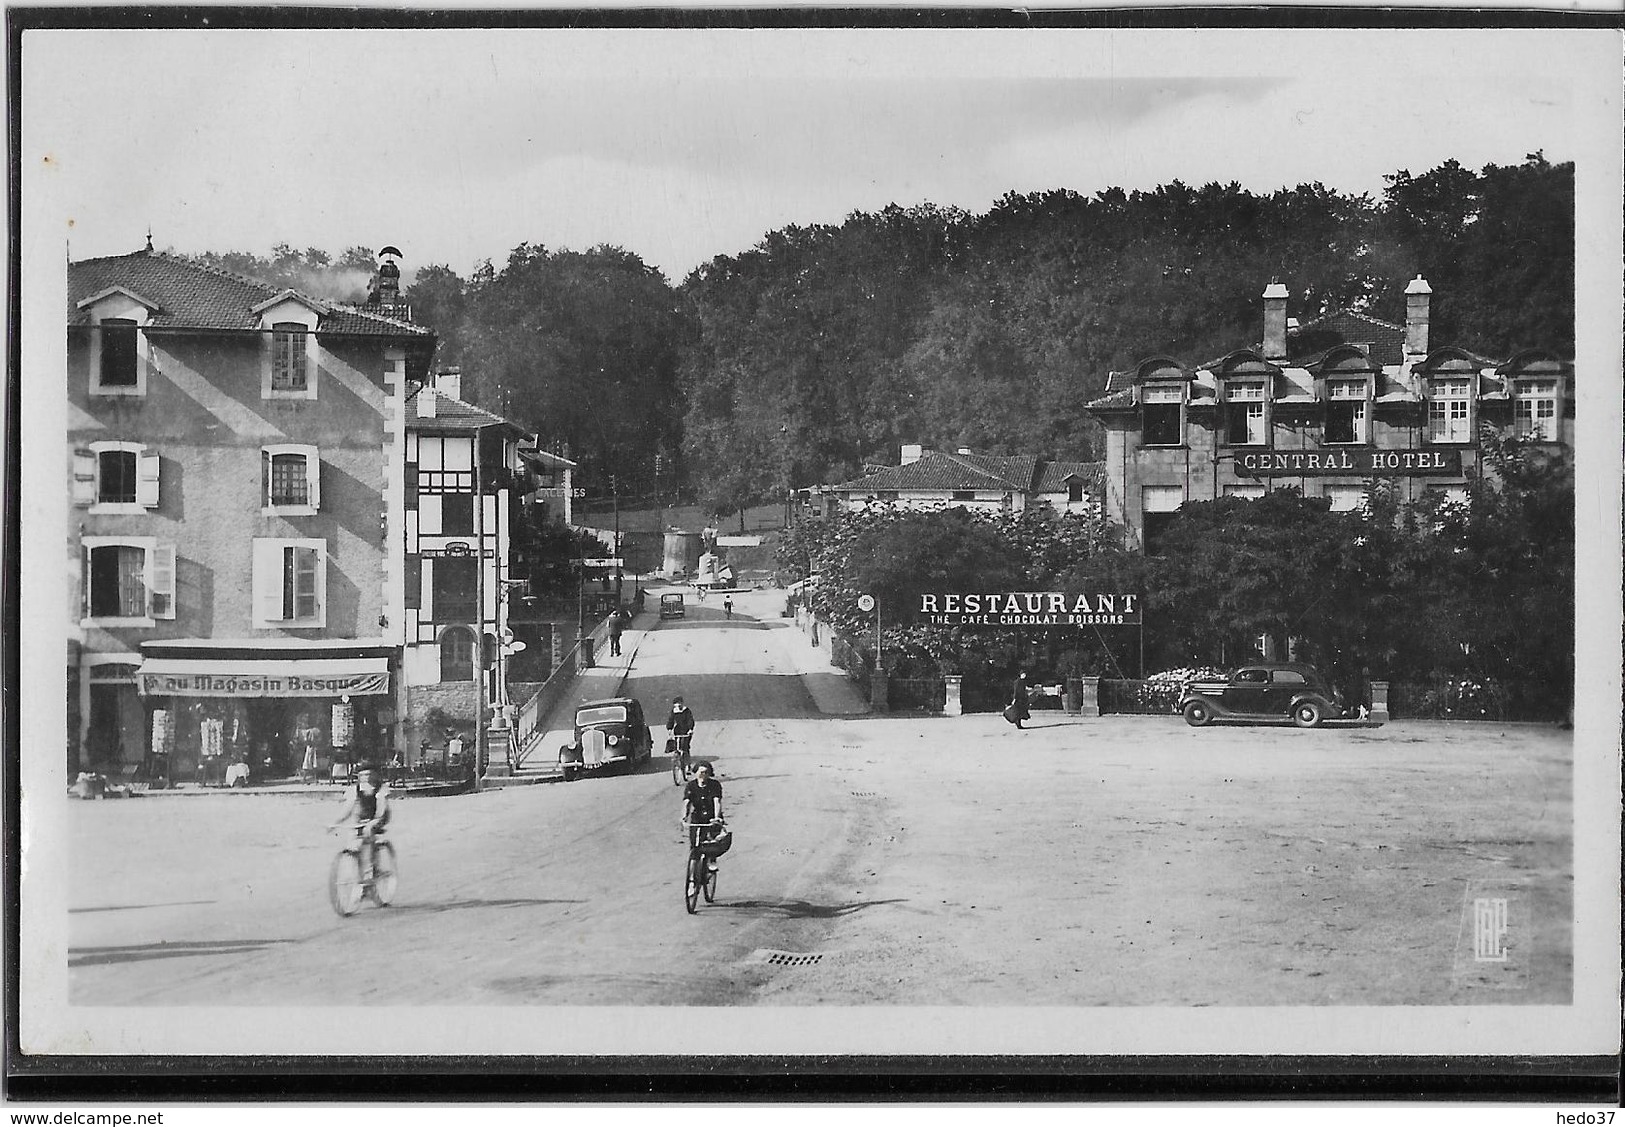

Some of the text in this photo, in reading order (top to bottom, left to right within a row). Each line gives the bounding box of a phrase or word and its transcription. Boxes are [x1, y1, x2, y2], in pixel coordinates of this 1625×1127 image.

[1244, 452, 1446, 469] CENTRAL HÔTEL
[920, 593, 1137, 613] RESTAURANT
[1000, 614, 1057, 624] CHOCOLAT
[1068, 614, 1124, 624] BOISSONS
[165, 676, 360, 693] au Magasin Basque
